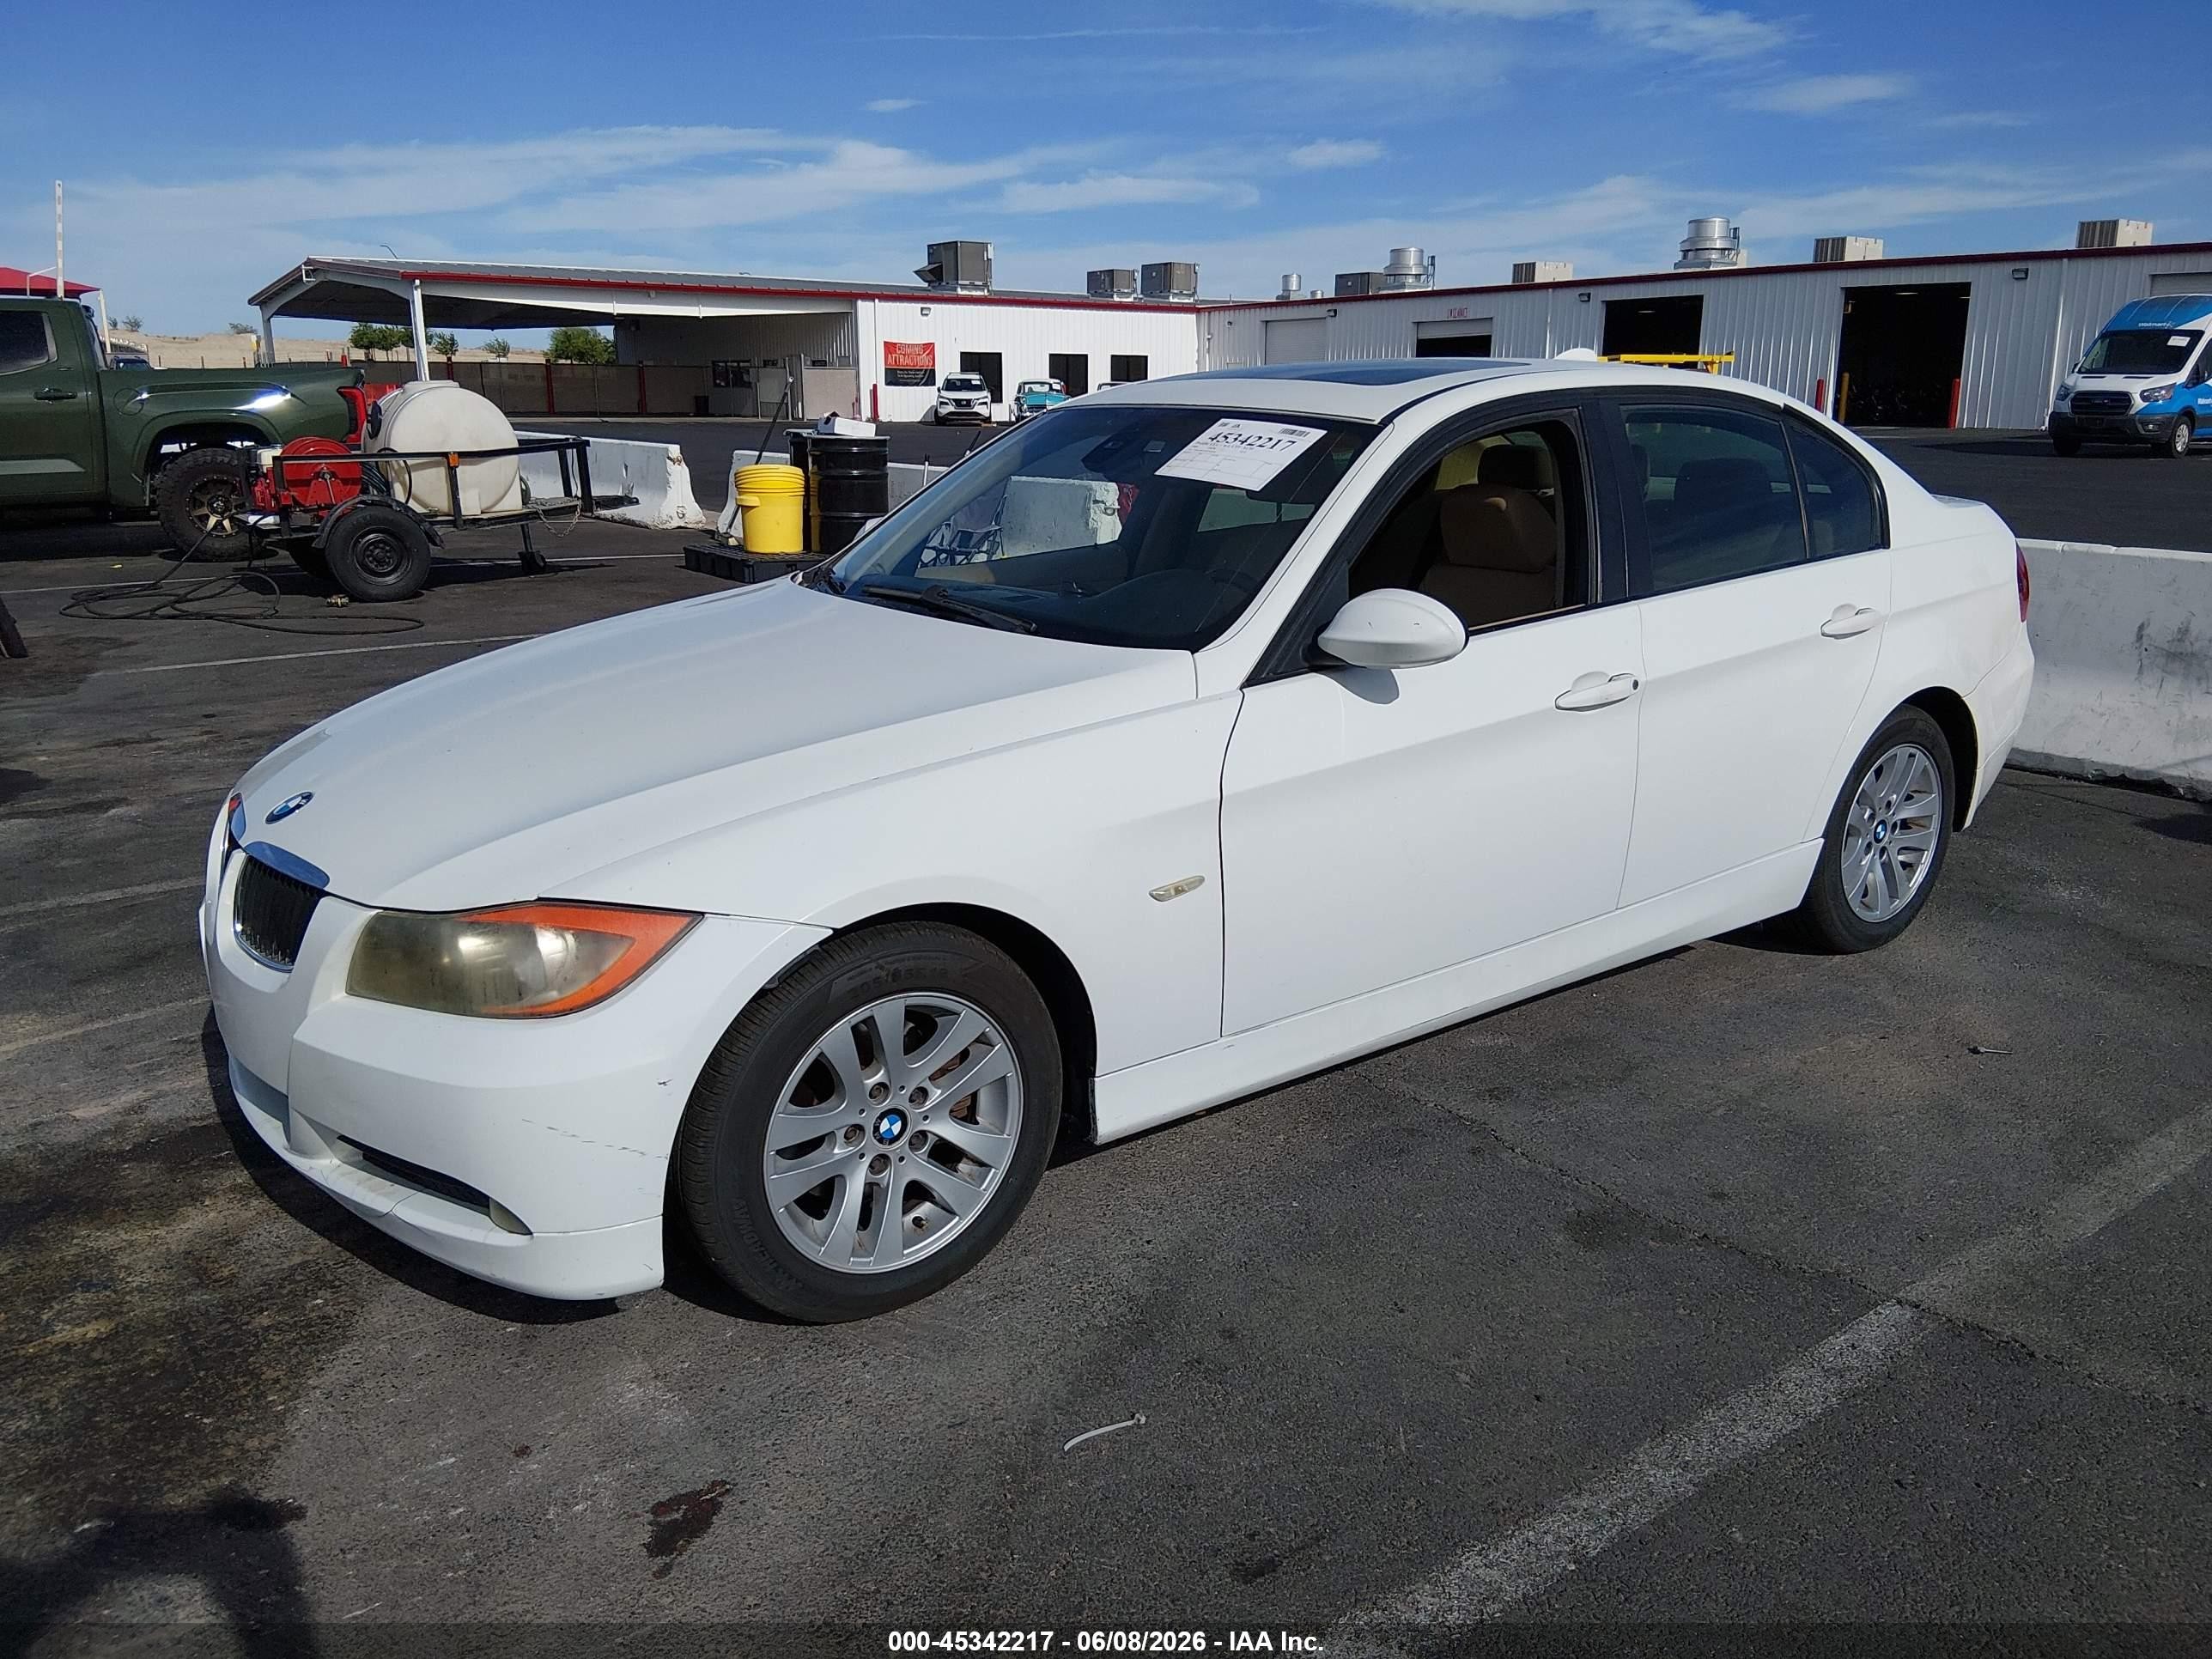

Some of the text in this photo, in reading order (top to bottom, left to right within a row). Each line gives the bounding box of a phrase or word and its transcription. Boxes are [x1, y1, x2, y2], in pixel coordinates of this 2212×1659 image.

[896, 343, 924, 354] COMING
[887, 354, 933, 366] ATTRACTIONS
[1207, 431, 1297, 452] 45342217
